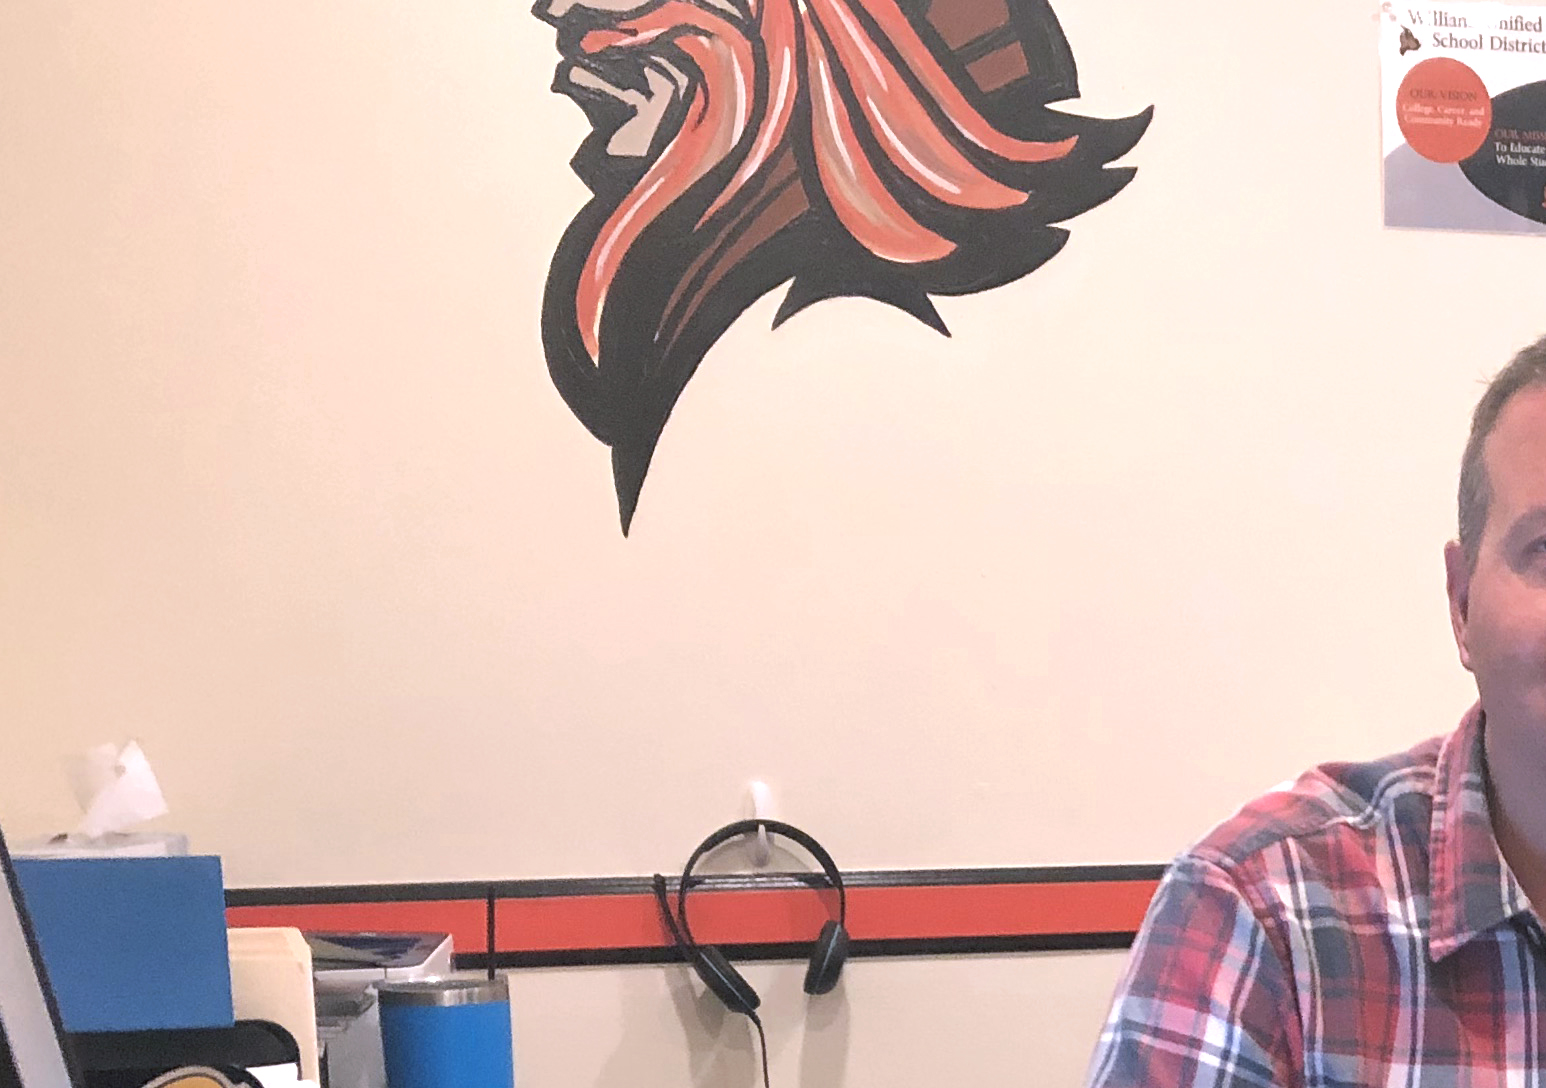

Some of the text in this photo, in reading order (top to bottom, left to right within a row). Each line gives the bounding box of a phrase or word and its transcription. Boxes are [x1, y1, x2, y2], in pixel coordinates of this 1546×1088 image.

[1487, 15, 1542, 32] nified
[1432, 32, 1483, 49] School
[1490, 35, 1546, 54] District
[1495, 142, 1507, 152] To
[1510, 142, 1546, 154] Educate
[1496, 154, 1528, 165] Whole
